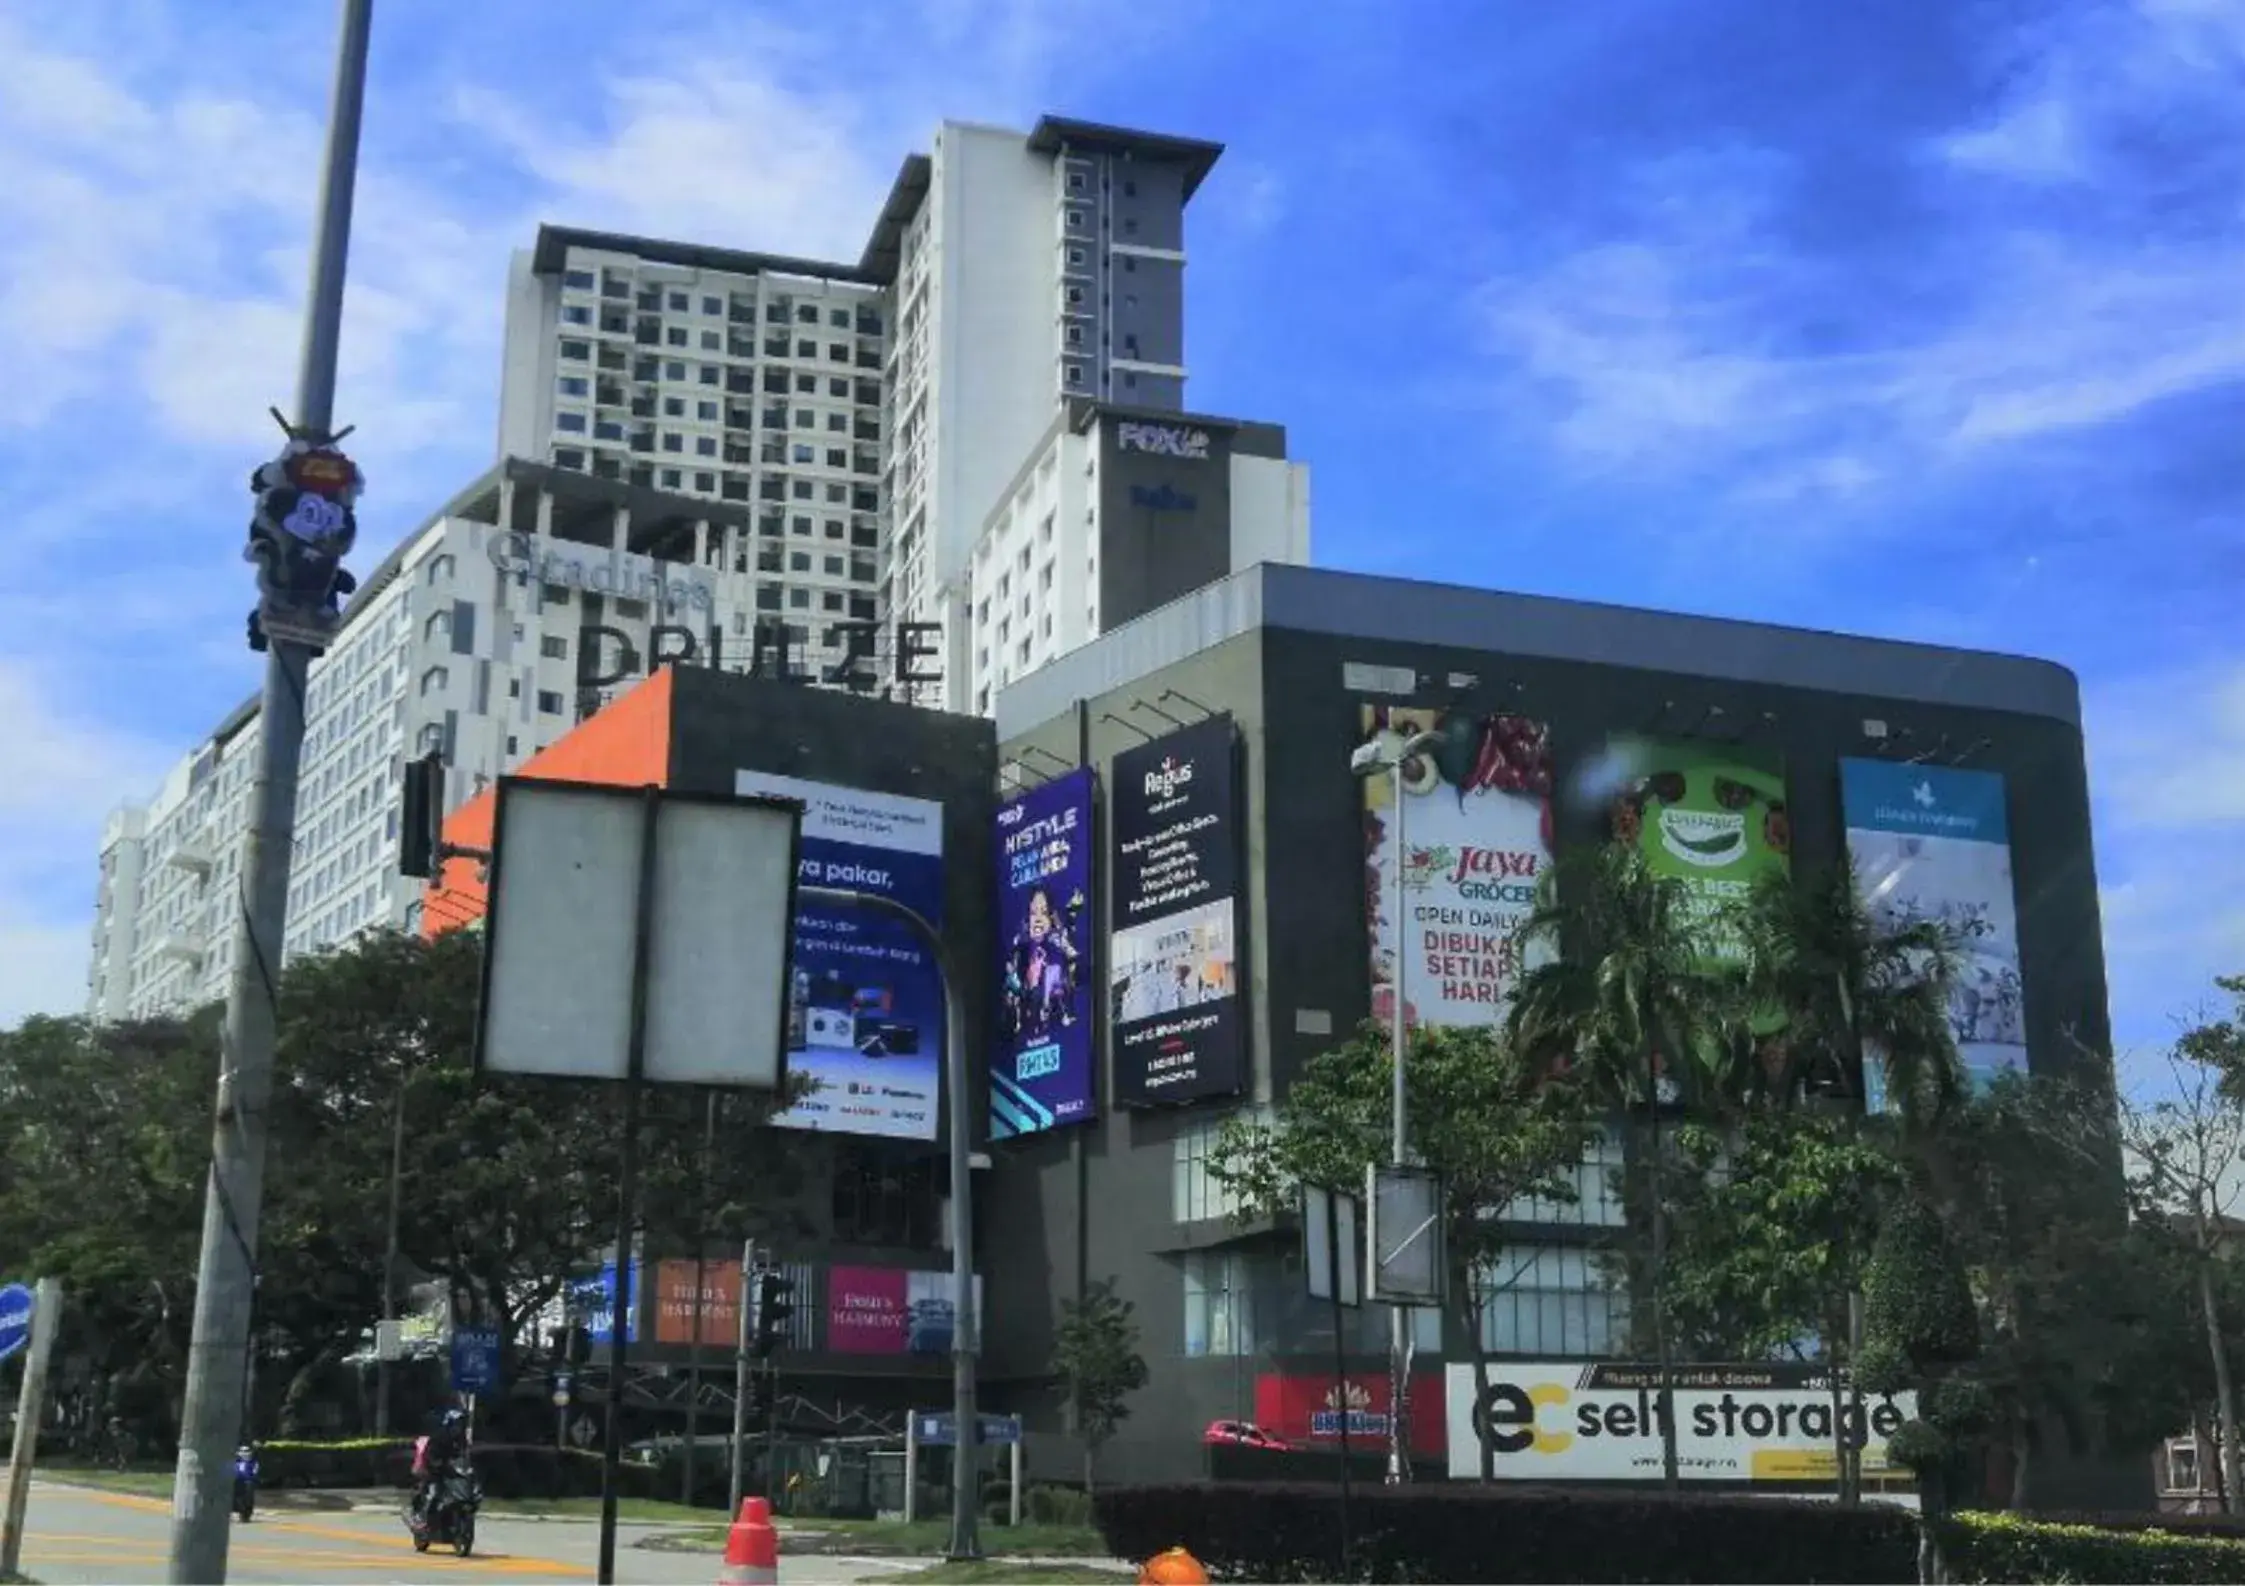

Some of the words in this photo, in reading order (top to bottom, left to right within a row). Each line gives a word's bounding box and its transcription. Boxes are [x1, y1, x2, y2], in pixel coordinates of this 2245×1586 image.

[826, 862, 894, 889] pakar,
[1415, 906, 1463, 925] OPEN
[1470, 909, 1519, 930] DAILY
[1424, 930, 1513, 956] DIBUKA
[1427, 954, 1511, 980] SETIAP
